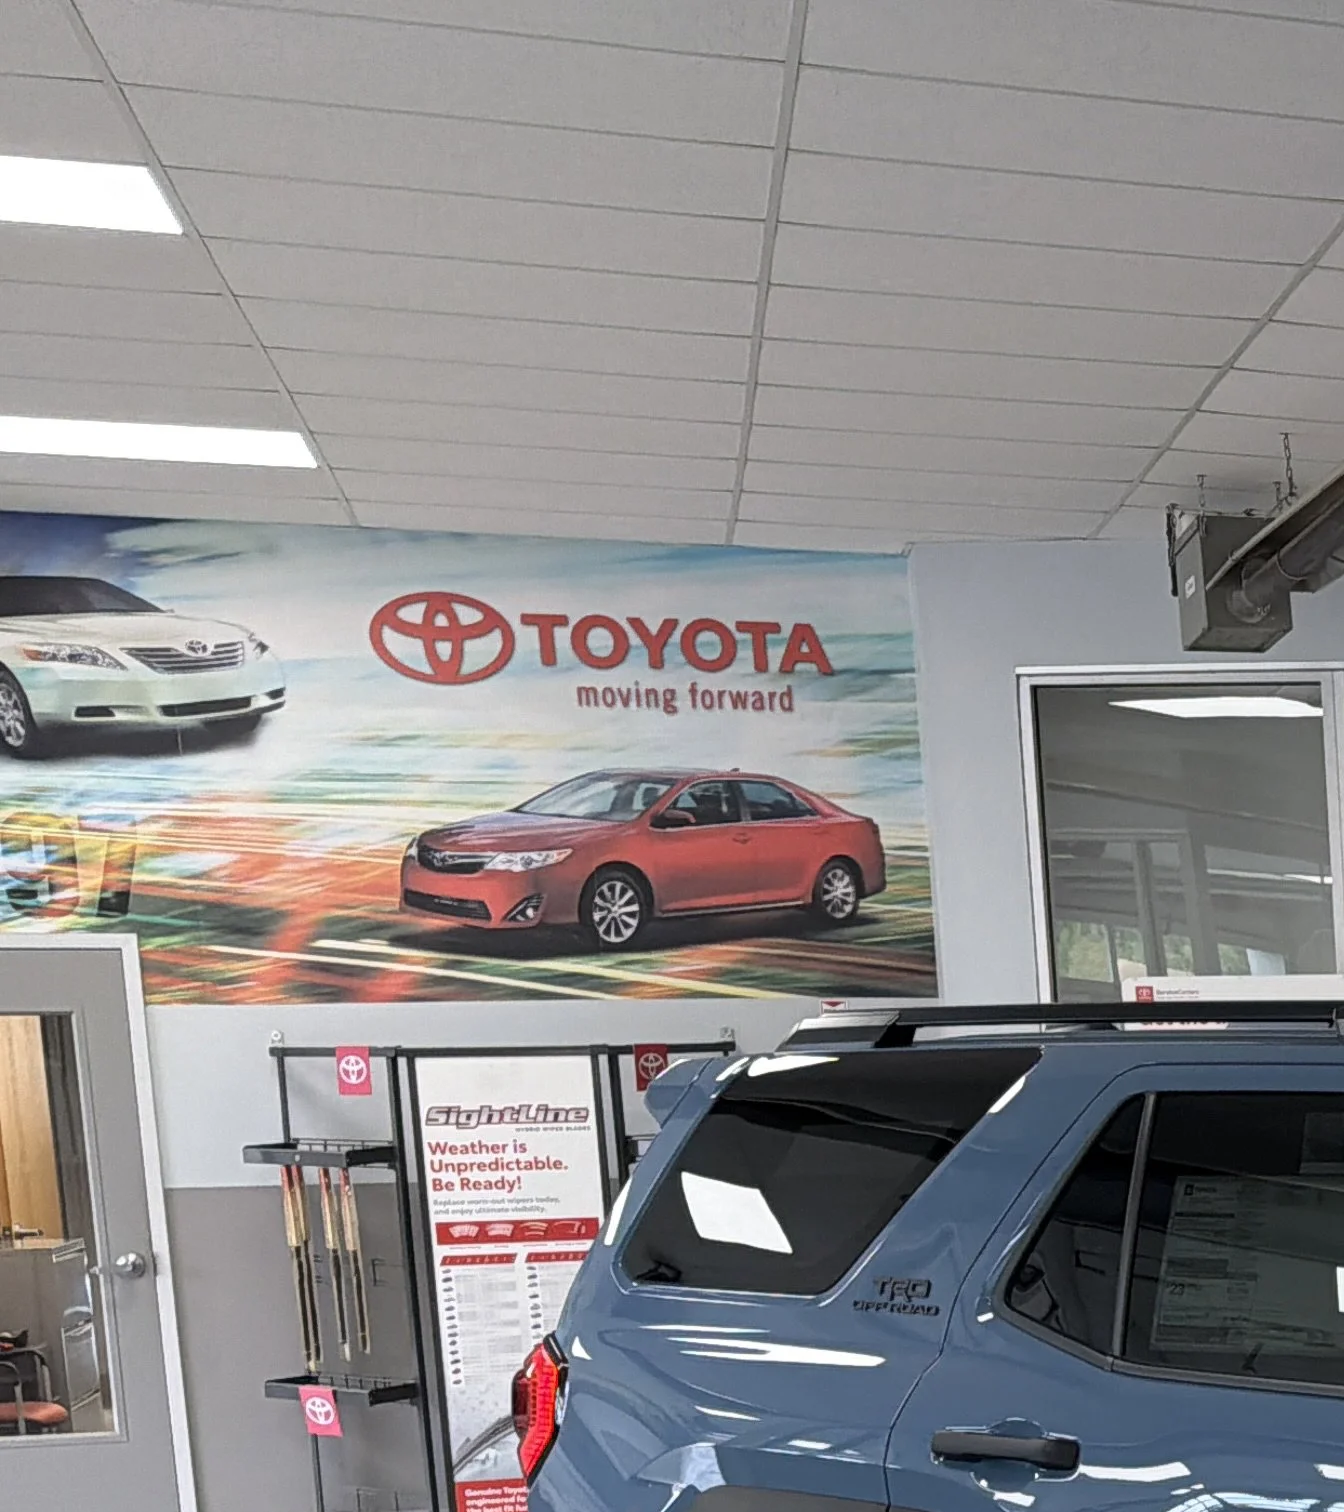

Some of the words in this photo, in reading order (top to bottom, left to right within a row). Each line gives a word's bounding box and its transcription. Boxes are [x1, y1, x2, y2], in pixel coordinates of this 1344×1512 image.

[520, 612, 834, 676] TOYOTA
[576, 680, 679, 715] moving
[688, 681, 795, 713] forward
[425, 1104, 590, 1129] SightLine
[427, 1139, 510, 1156] Weather
[513, 1138, 528, 1154] is
[430, 1155, 569, 1177] Unpredictable.
[432, 1177, 455, 1192] Be
[459, 1175, 523, 1193] Ready!
